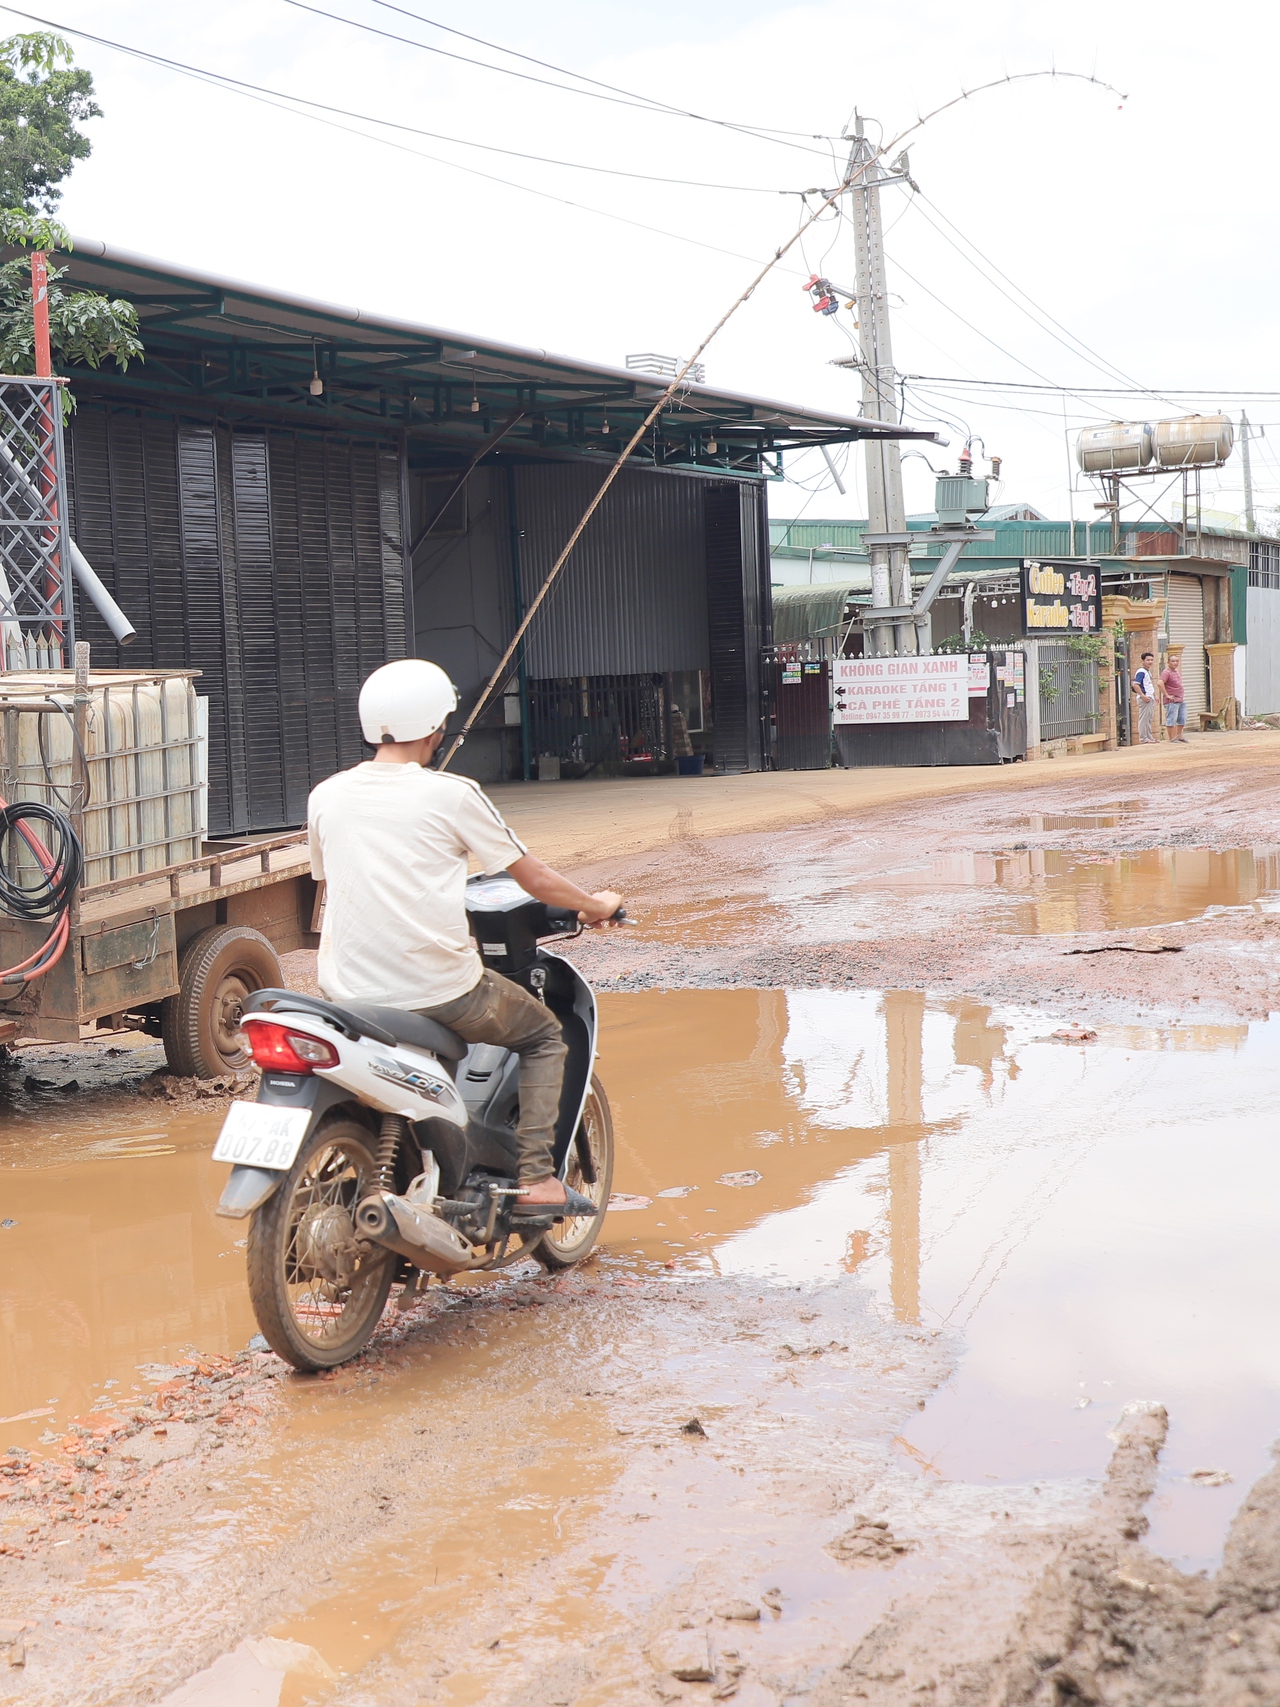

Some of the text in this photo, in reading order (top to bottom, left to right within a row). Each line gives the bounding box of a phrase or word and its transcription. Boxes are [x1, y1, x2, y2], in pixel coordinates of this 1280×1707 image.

[1029, 565, 1064, 595] Coffee
[1088, 574, 1096, 596] 2
[1026, 598, 1069, 627] Karaoke
[1088, 605, 1095, 627] 1
[840, 662, 883, 677] KHÔNG
[887, 662, 918, 676] GIAN
[922, 661, 958, 673] XANH
[848, 684, 907, 696] KARAOKE
[952, 683, 958, 691] 1
[848, 700, 867, 711] CÀ
[872, 698, 901, 710] PHÊ
[951, 698, 960, 707] 2
[840, 712, 865, 720] Hotline:
[866, 712, 881, 720] 0947
[882, 711, 891, 719] 35
[892, 711, 900, 719] 99
[901, 711, 909, 719] 77
[915, 710, 931, 718] 0973
[932, 710, 941, 718] 54
[942, 710, 950, 718] 44
[952, 709, 960, 717] 77
[269, 1079, 296, 1088] HONDA
[219, 1133, 294, 1165] 007.88
